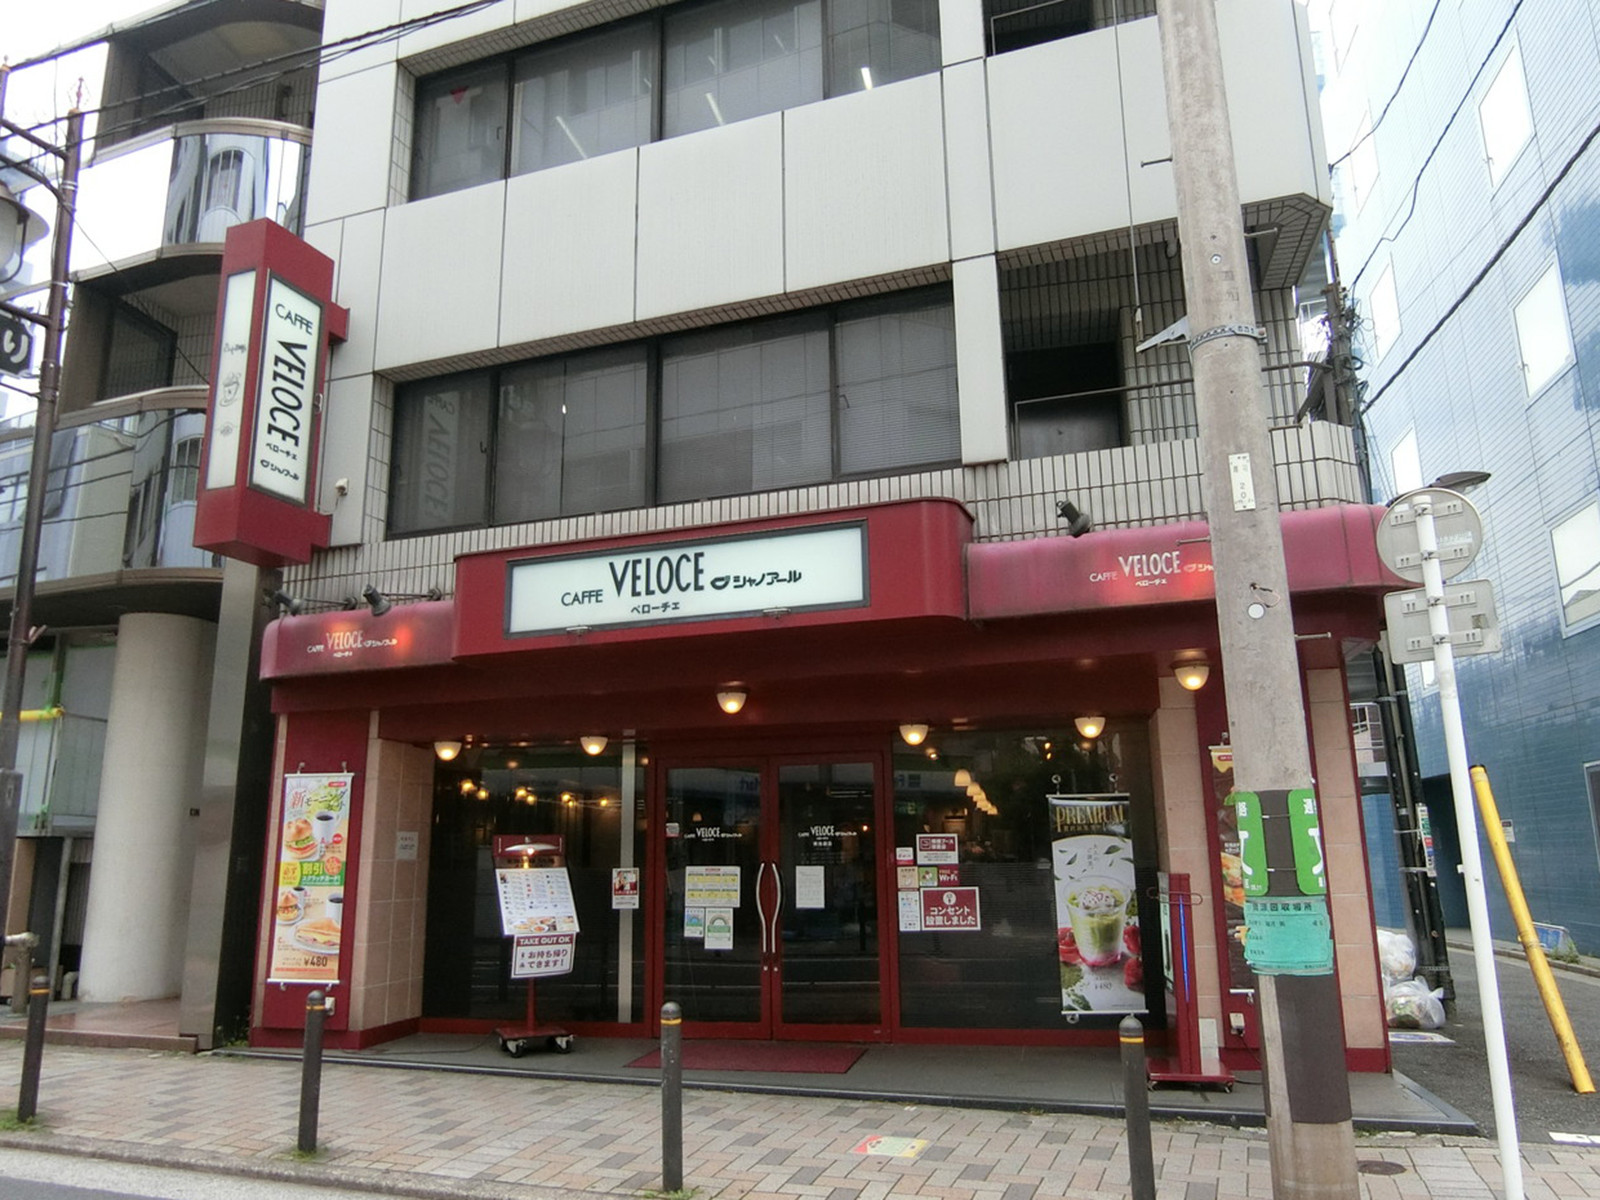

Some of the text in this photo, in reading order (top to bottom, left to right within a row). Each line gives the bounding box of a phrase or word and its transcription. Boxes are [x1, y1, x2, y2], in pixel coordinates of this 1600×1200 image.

[275, 303, 313, 335] CAFFE
[267, 339, 308, 447] VELOCE
[1089, 571, 1118, 582] CAFFE
[1118, 551, 1181, 577] VELOCE
[561, 552, 705, 607] CAFFE VELOCE
[733, 570, 802, 588] シャノアール
[631, 601, 681, 614] ベローチェ
[326, 631, 363, 650] VELOCE
[1055, 804, 1125, 833] PREMIUM
[696, 827, 720, 838] VELOCE
[811, 826, 835, 837] VELOCE
[930, 906, 971, 915] コンセント
[925, 916, 976, 926] 設置しました
[520, 937, 539, 945] TAKE
[528, 949, 568, 958] お持ち帰り
